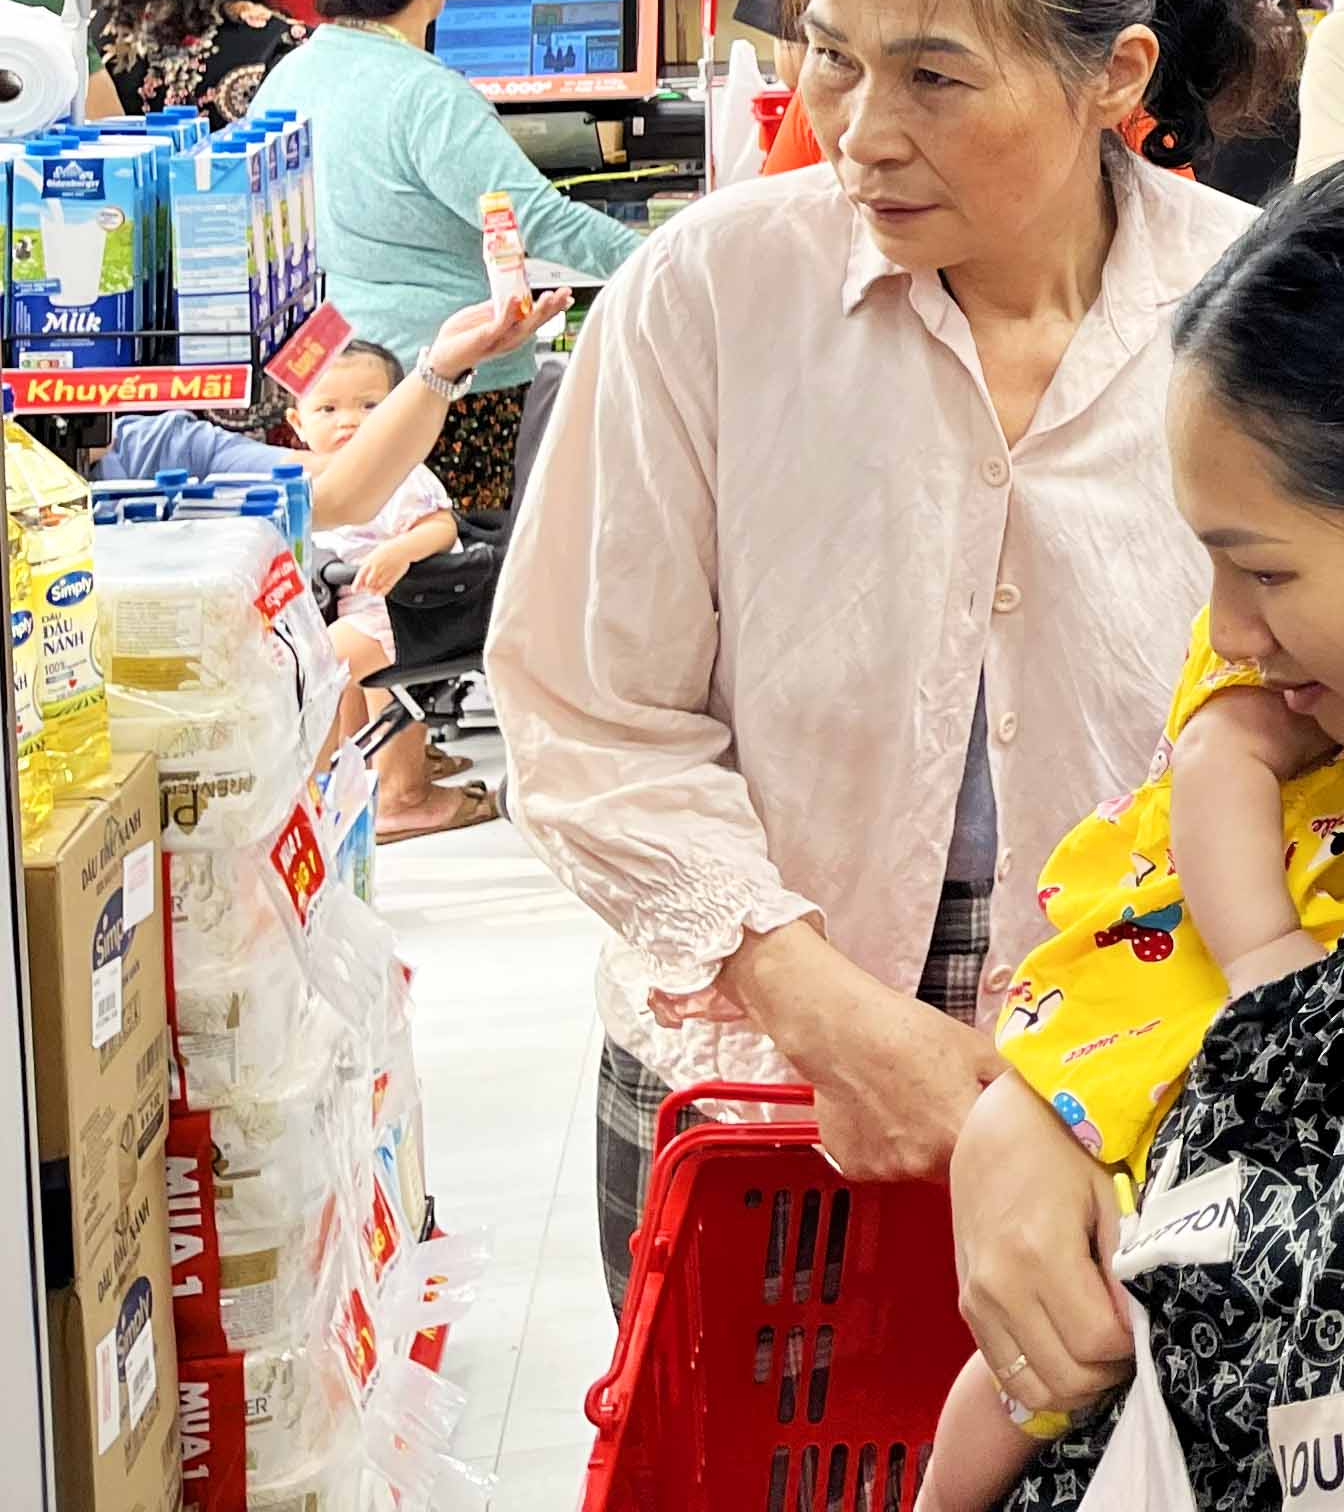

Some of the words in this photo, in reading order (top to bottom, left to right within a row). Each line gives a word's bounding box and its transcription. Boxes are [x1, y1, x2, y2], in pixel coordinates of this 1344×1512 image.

[42, 310, 102, 334] Milk
[27, 374, 158, 410] Khuyến
[169, 373, 233, 399] Mãi
[51, 576, 92, 603] Simply
[166, 1155, 206, 1267] MUA
[179, 1382, 212, 1458] MUA
